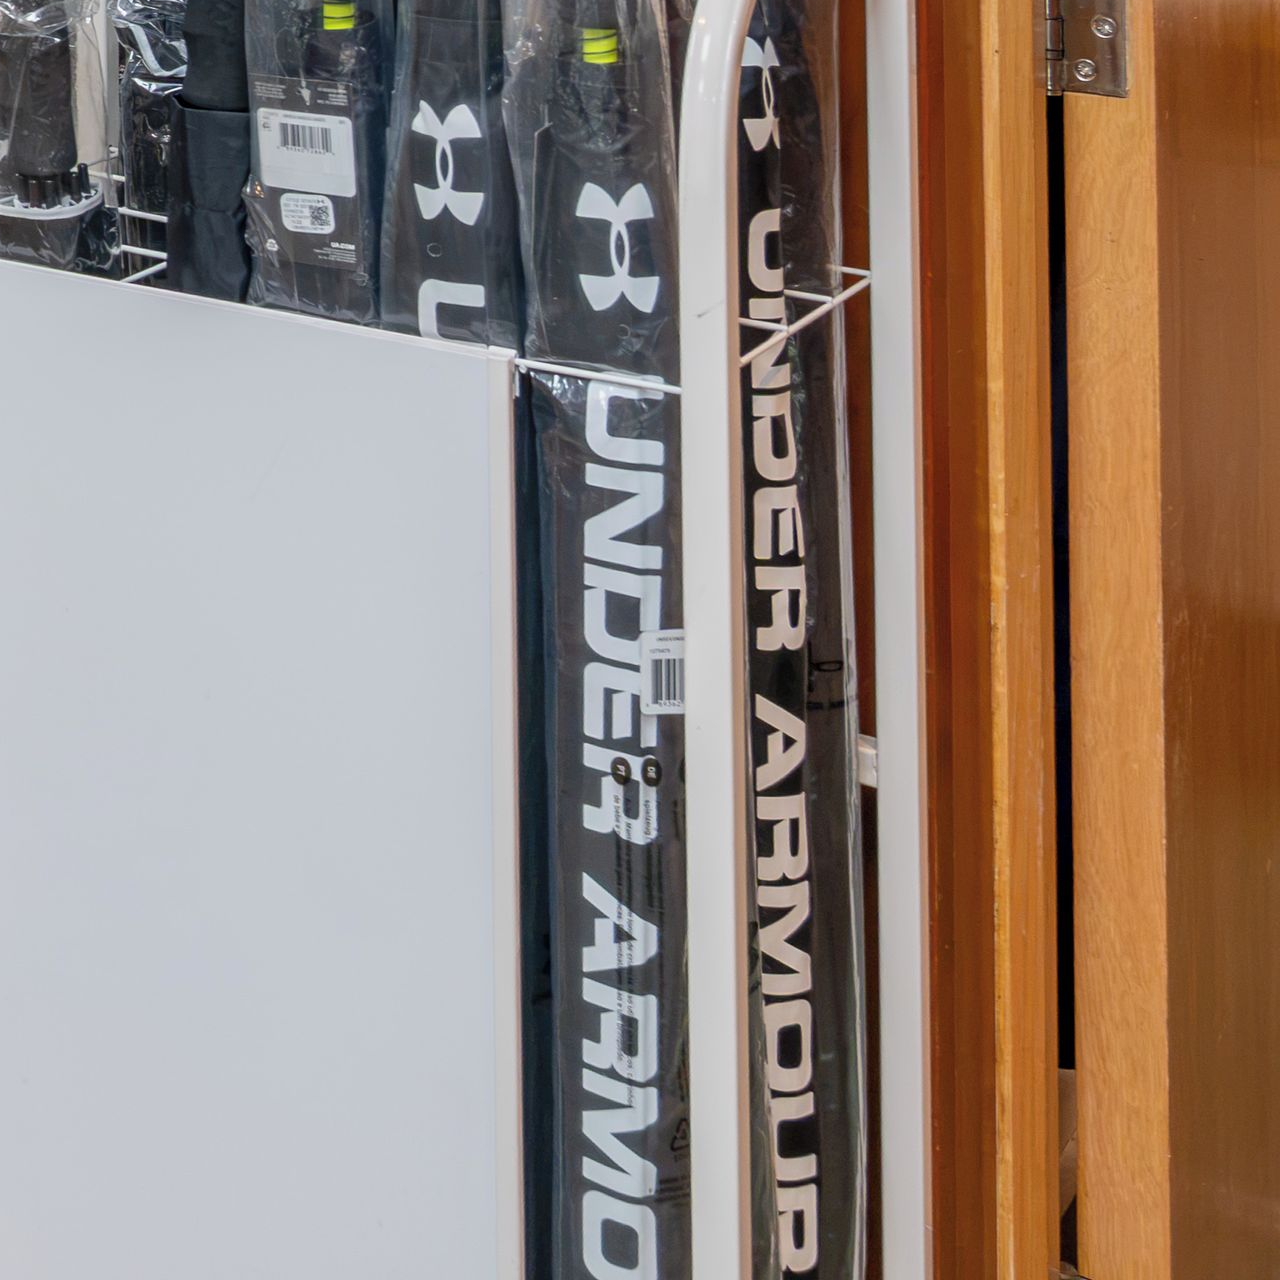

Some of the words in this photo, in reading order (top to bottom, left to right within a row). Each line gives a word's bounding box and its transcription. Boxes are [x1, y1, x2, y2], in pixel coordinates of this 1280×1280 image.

[582, 374, 666, 846] UNDER
[748, 208, 807, 652] UNDER
[647, 766, 657, 778] DE
[755, 693, 820, 1274] ARMOUR
